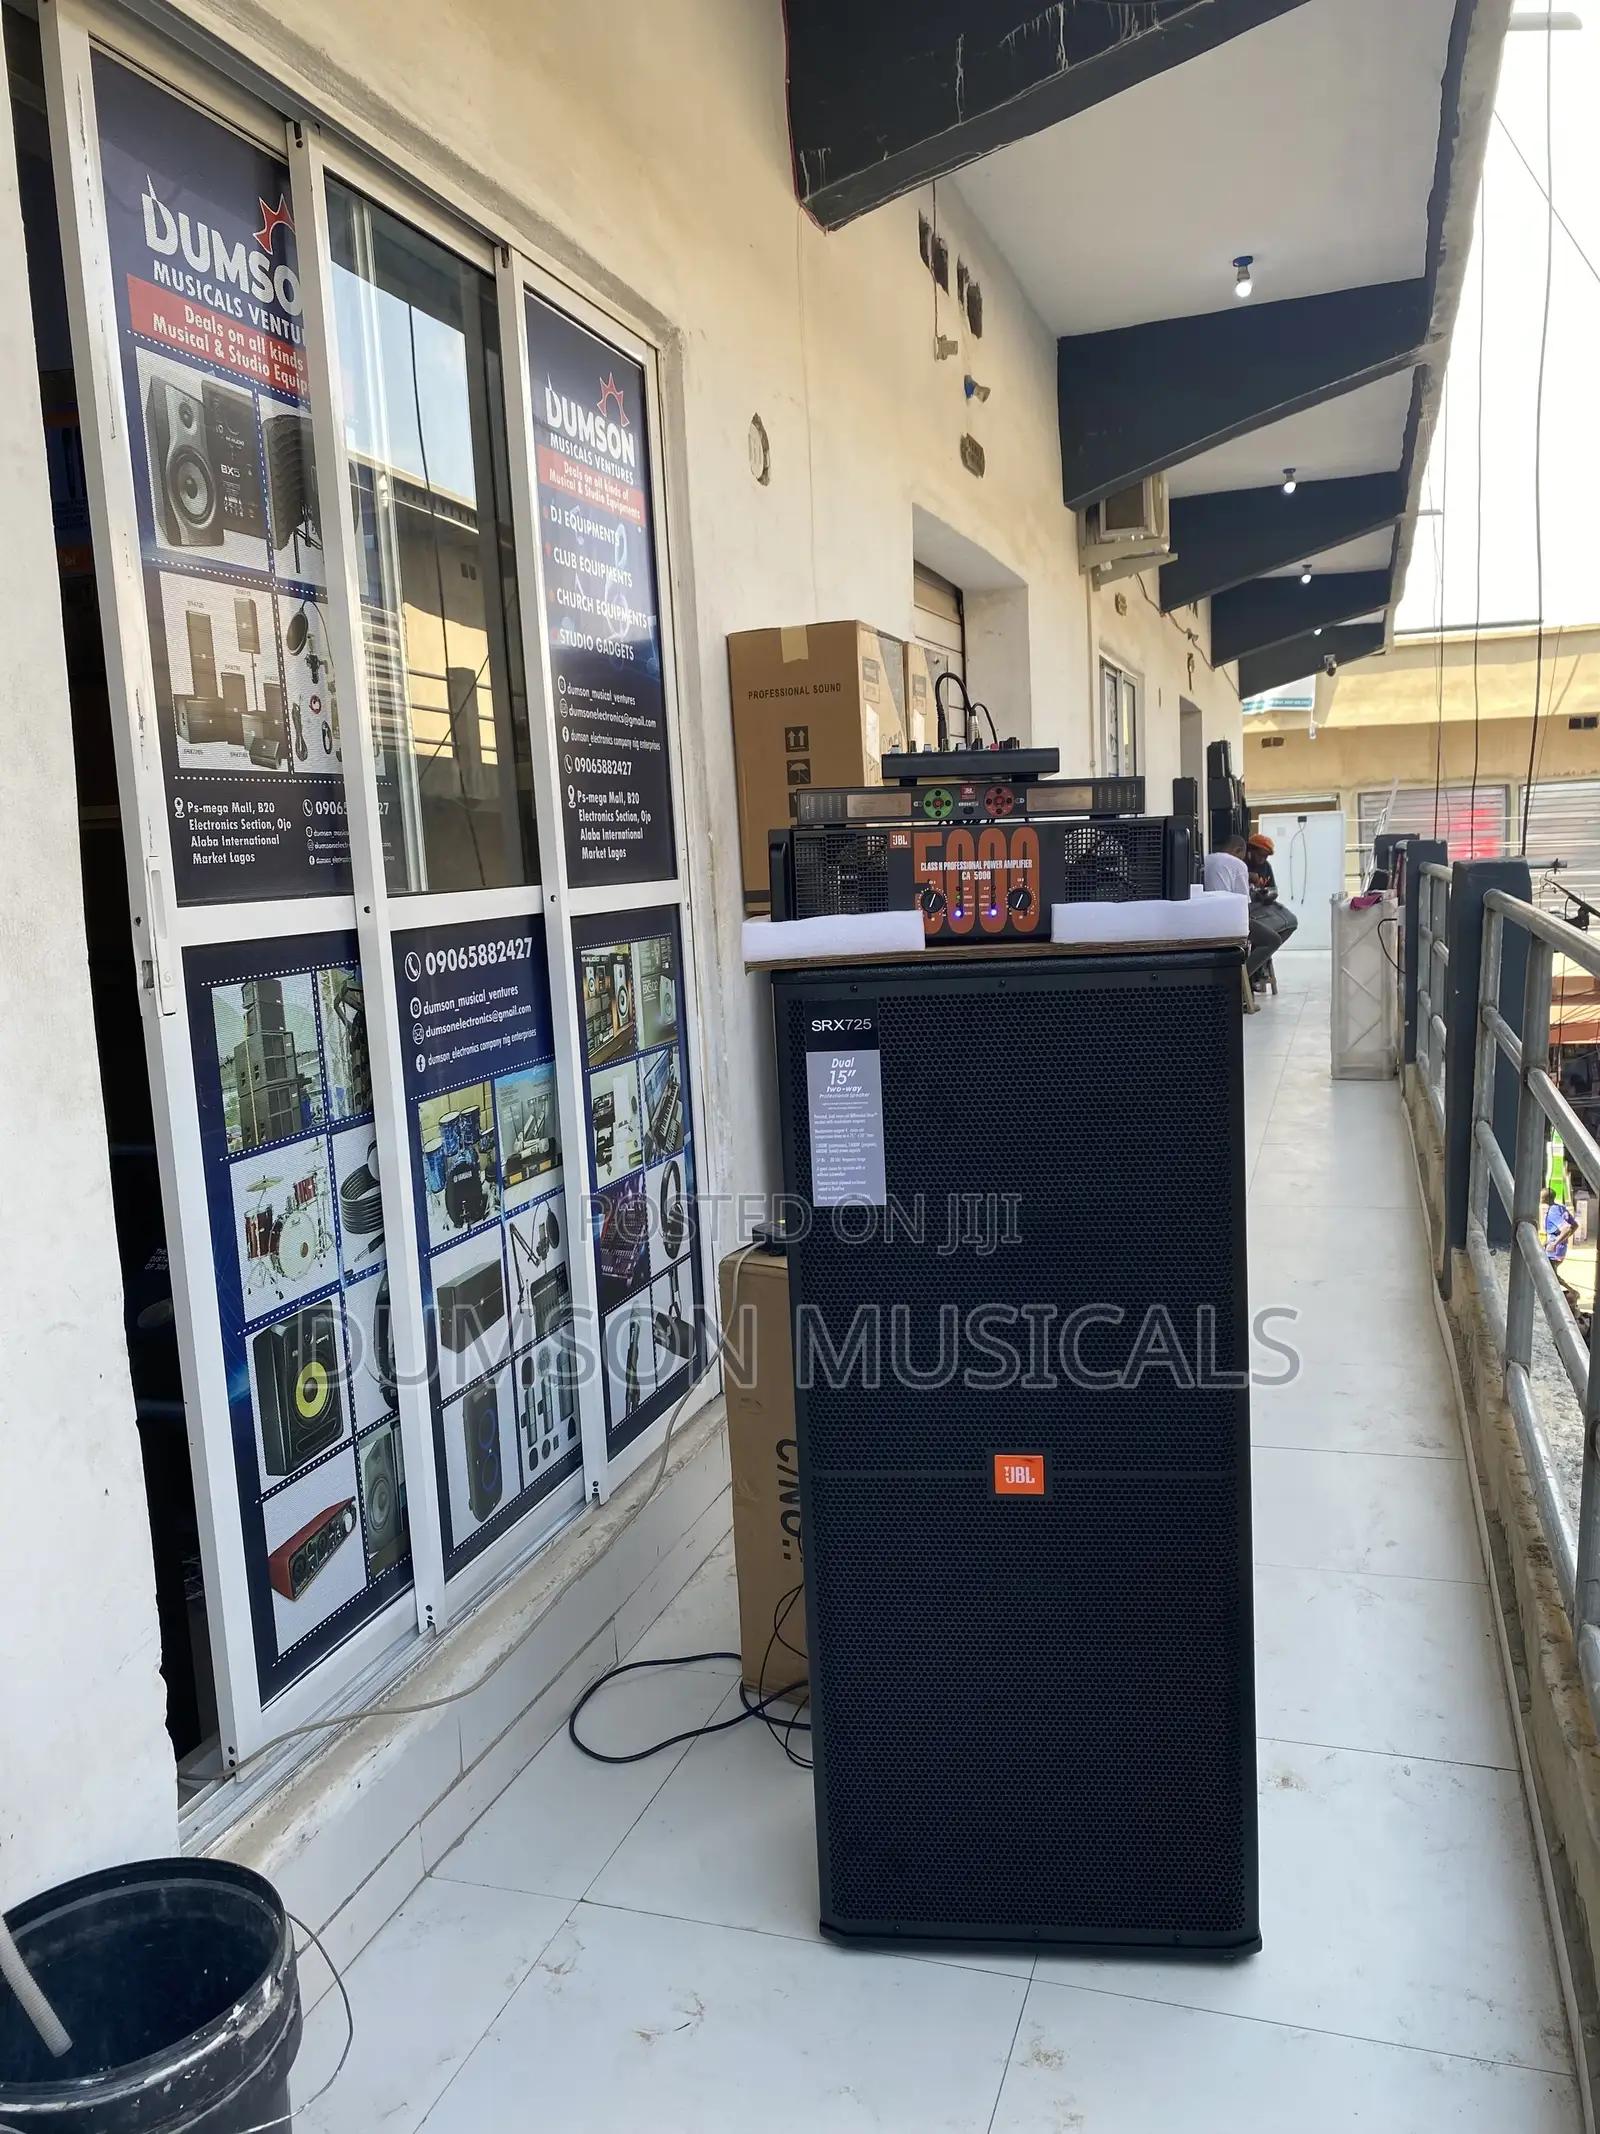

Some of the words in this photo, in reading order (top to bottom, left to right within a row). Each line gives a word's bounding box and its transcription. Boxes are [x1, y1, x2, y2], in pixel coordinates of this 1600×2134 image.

[142, 174, 304, 317] DUMSO
[154, 260, 244, 319] MUSICALS
[153, 313, 210, 353] Musical
[214, 340, 225, 359] &
[229, 346, 270, 377] Studio
[185, 305, 224, 337] Deals
[228, 328, 245, 347] on
[250, 334, 266, 355] all
[270, 341, 304, 372] kinds
[545, 372, 635, 468] DUMSON
[550, 433, 593, 466] MUSICALS
[595, 454, 634, 486] VENTURES
[564, 461, 583, 480] Deals
[549, 468, 576, 491] Musical
[585, 484, 605, 504] Studio
[550, 505, 562, 525] DJ
[564, 510, 620, 546] EQUIPMENTS
[553, 546, 577, 570] CLUB
[579, 555, 633, 588] EQUIPMENTS
[556, 588, 594, 613] CHURCH
[596, 599, 648, 629] EQUIPMENTS
[559, 628, 594, 651] STUDIO
[596, 638, 635, 661] GADGETS
[748, 686, 810, 700] PROFESSIONAL
[813, 682, 842, 694] SOUND
[574, 756, 632, 776] 09065882427
[577, 790, 608, 807] Ps-mega
[608, 791, 627, 806] Mall,
[627, 792, 641, 805] B20
[187, 801, 229, 816] Ps-mega
[231, 802, 256, 815] Mall,
[257, 802, 275, 813] B20
[579, 809, 614, 822] Electronics
[615, 810, 640, 824] Section,
[640, 810, 652, 825] Ojo
[189, 819, 239, 831] Electronics
[240, 819, 275, 831] Section,
[277, 818, 292, 832] Ojo
[580, 828, 601, 841] Alaba
[602, 828, 644, 841] International
[190, 835, 219, 848] Alaba
[221, 834, 280, 847] International
[892, 834, 908, 845] JBL
[192, 852, 227, 865] Market
[229, 852, 256, 865] Lagos
[582, 846, 607, 860] Market
[608, 847, 627, 861] Lagos
[920, 862, 939, 871] CLASS
[943, 860, 983, 871] PROFESSIONAL
[983, 860, 1003, 869] POWER
[1003, 859, 1033, 869] AMPLIFIER
[914, 826, 1040, 934] 5000
[961, 871, 971, 880] CA
[974, 871, 991, 880] 5000
[425, 937, 533, 976] 09065882427
[423, 985, 519, 1016] dumson_musical_ventures
[425, 1004, 532, 1038] dumsonelectronics@gmail.com
[811, 1018, 872, 1032] SRX725
[831, 1057, 855, 1069] Dual
[826, 1085, 863, 1093] two-way
[1004, 1466, 1036, 1484] JBL
